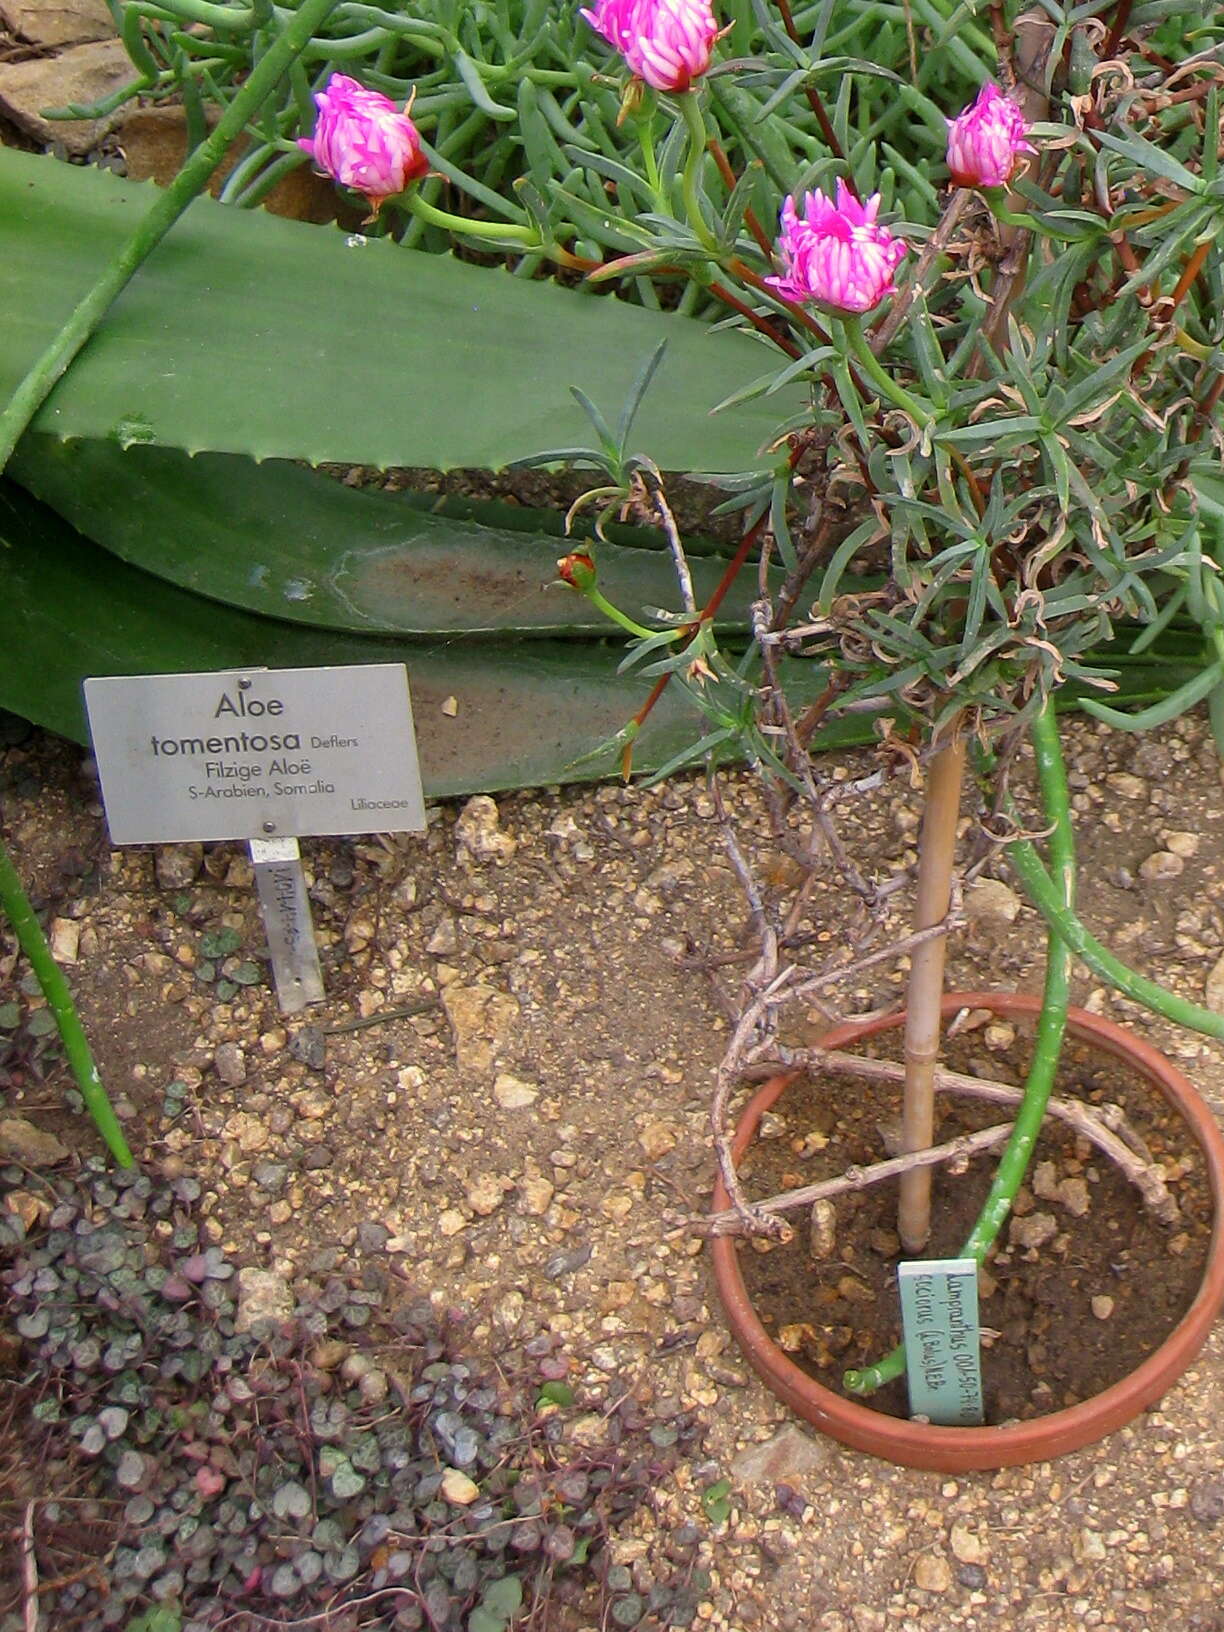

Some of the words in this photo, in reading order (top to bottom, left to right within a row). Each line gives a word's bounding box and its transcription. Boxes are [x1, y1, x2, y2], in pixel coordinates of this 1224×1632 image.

[214, 691, 284, 719] Aloe
[151, 732, 301, 757] tomentosa
[310, 735, 360, 750] Deflers
[205, 761, 262, 779] Filzige
[268, 758, 312, 776] Aloë
[189, 784, 270, 800] S-Arabien,
[274, 781, 336, 796] Somalia
[351, 798, 409, 811] Liliaceae
